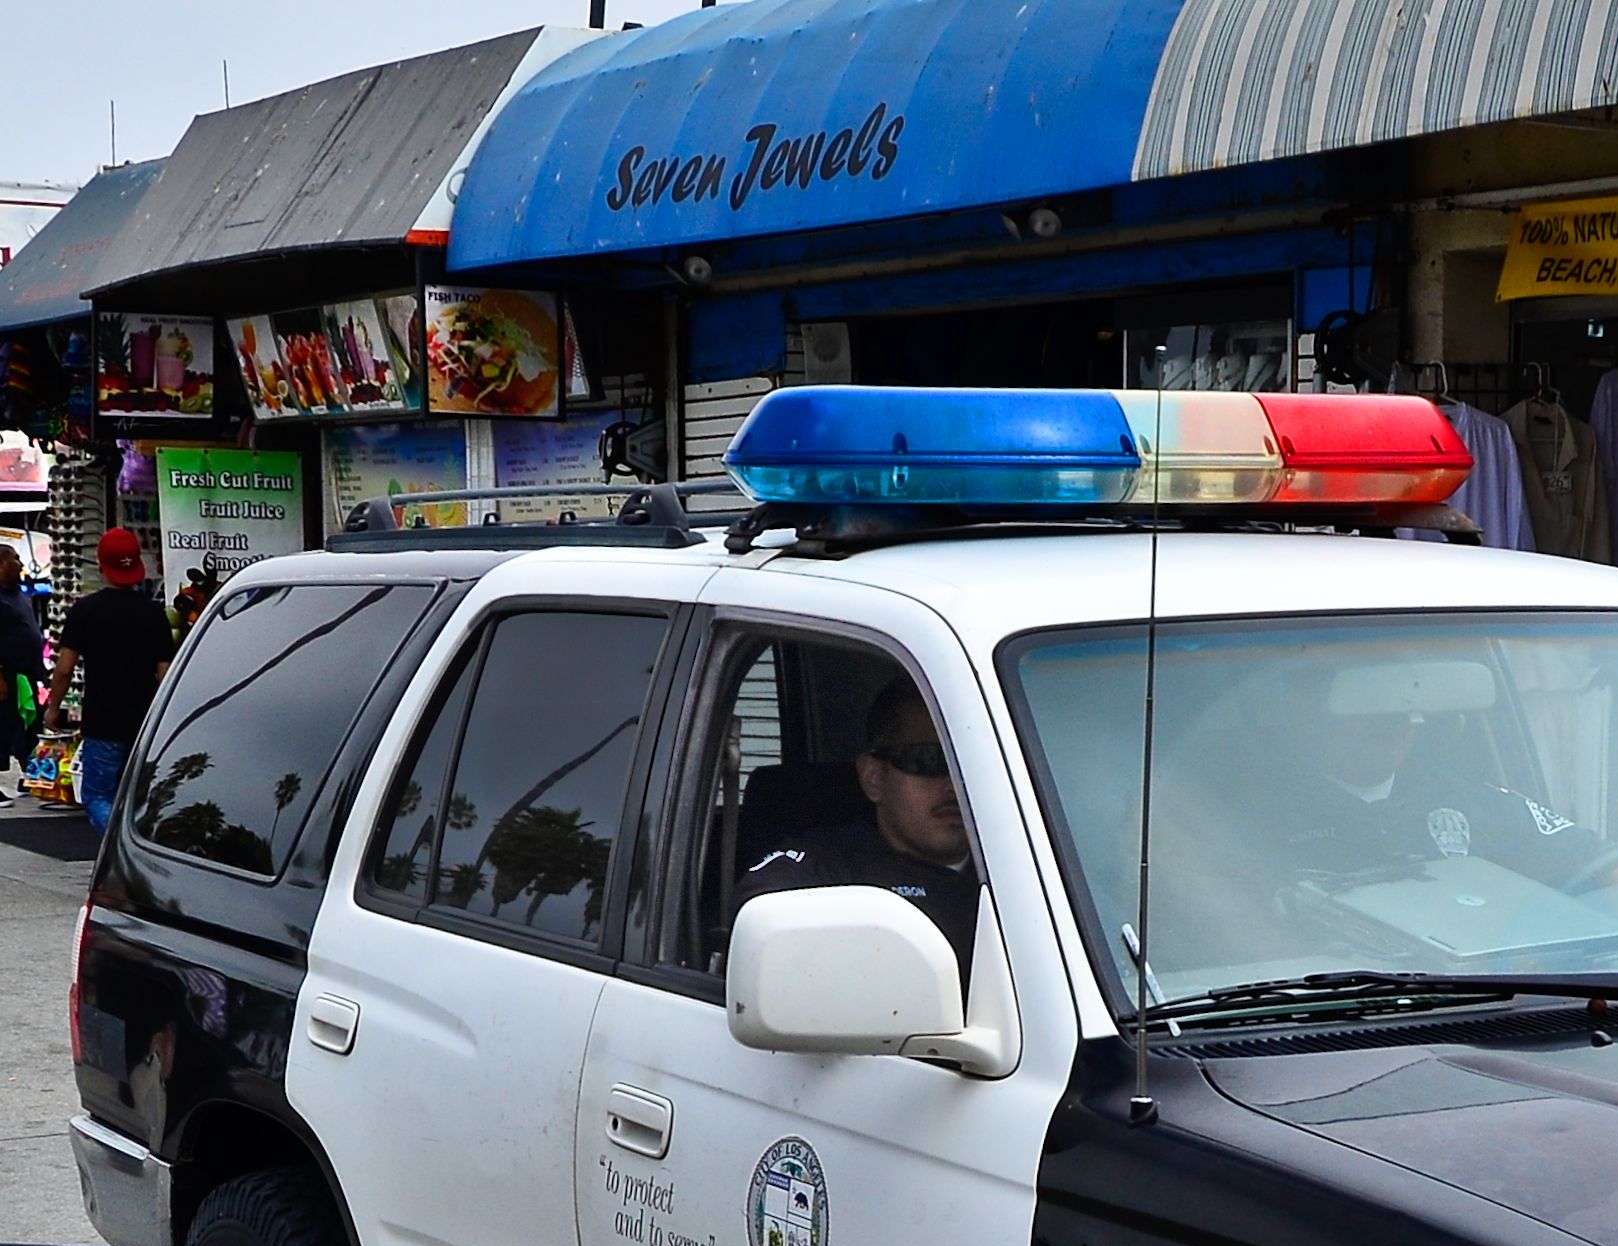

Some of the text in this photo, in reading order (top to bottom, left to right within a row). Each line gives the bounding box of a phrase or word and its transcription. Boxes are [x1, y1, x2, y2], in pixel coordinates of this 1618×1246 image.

[606, 101, 905, 212] Seven Jewels
[1519, 220, 1570, 246] 100%
[1535, 256, 1618, 288] BEACH,
[428, 292, 481, 304] FISH TACO
[169, 468, 294, 491] Fresh Cut Fruit
[200, 500, 285, 520] Fruit Juice
[168, 530, 249, 551] Real Fruit
[771, 1147, 783, 1161] OF
[785, 1142, 803, 1157] LOS
[622, 1175, 675, 1215] protect
[614, 1208, 644, 1243] and
